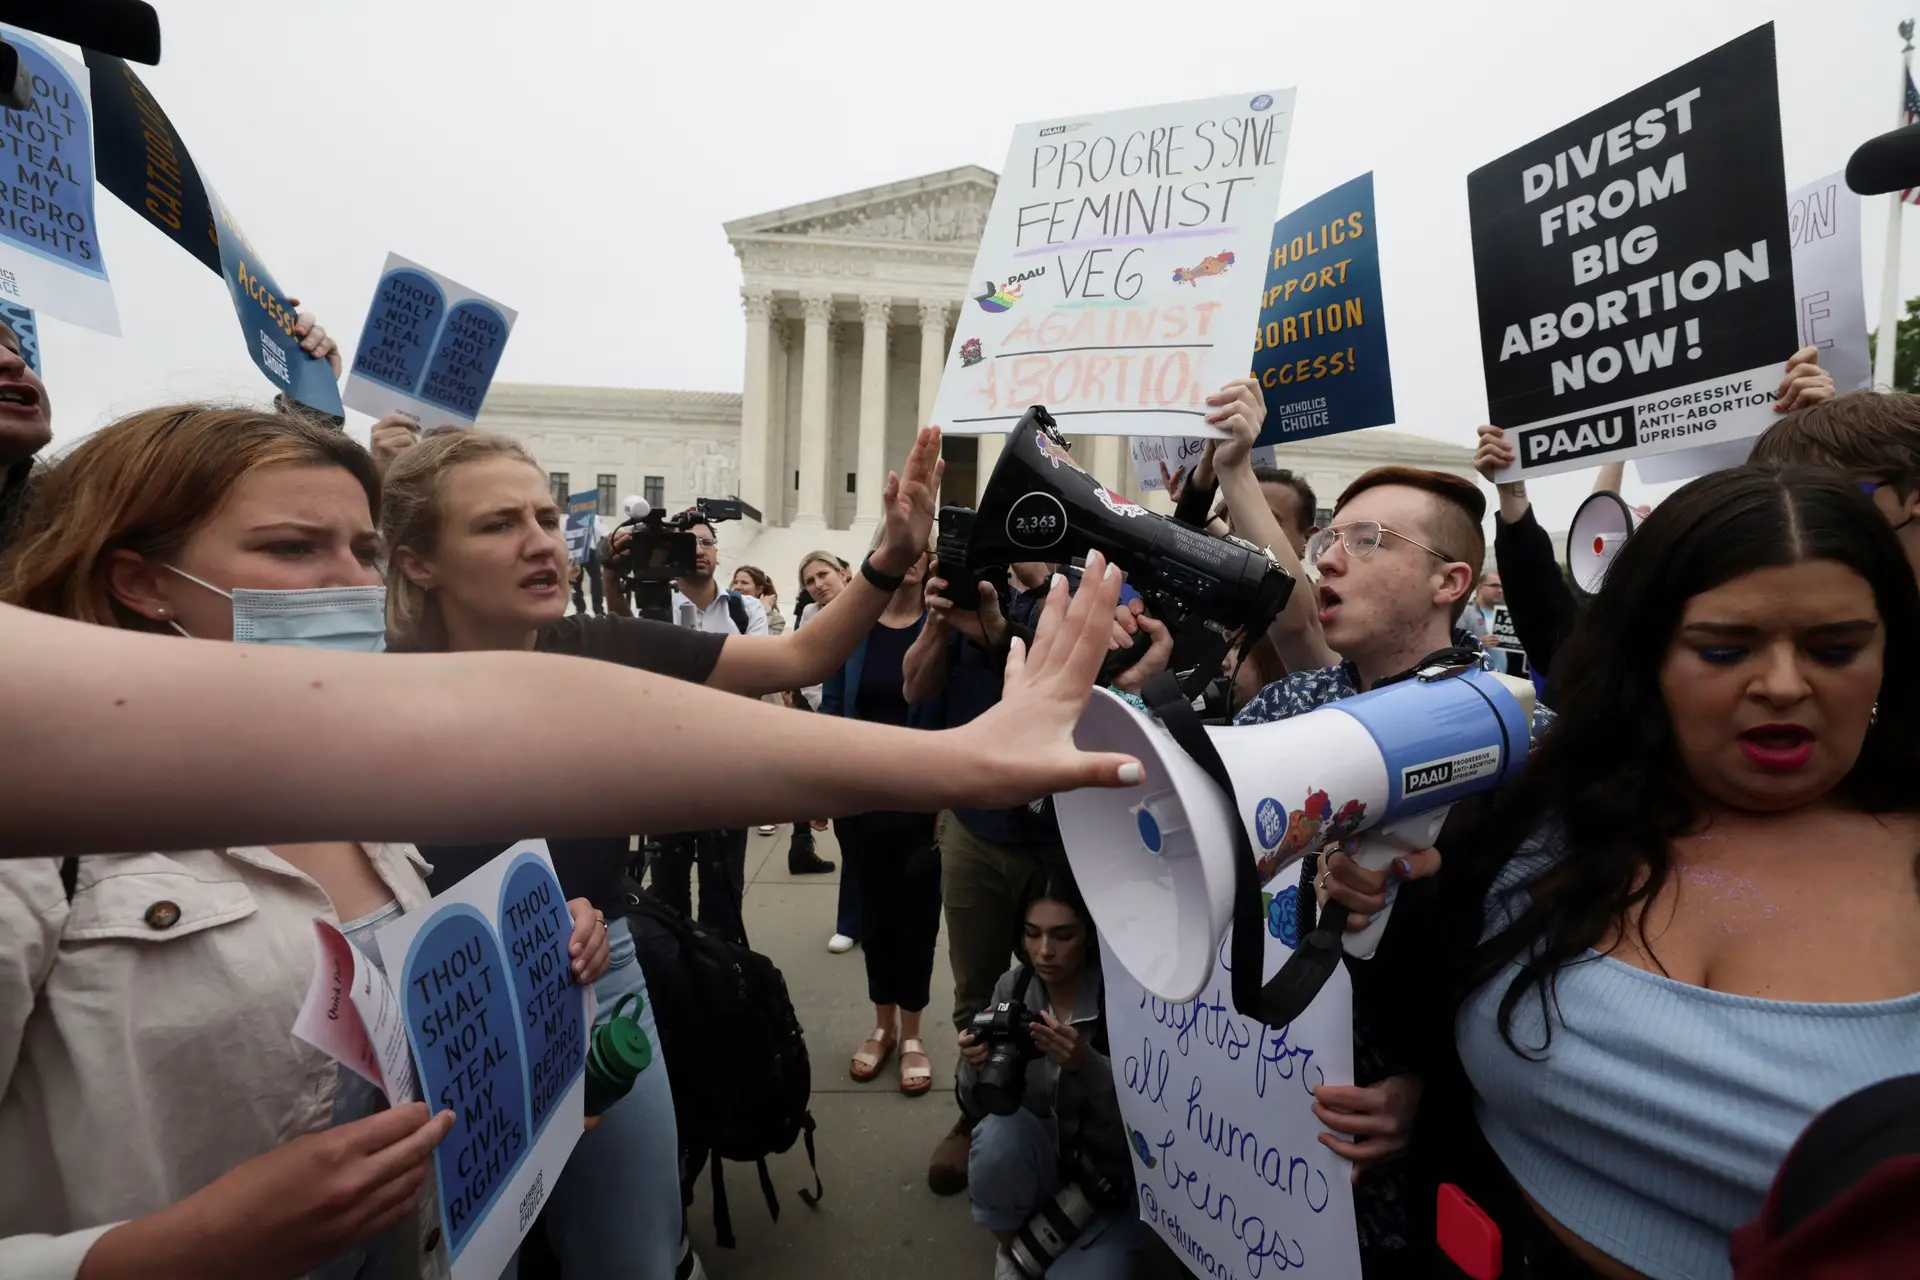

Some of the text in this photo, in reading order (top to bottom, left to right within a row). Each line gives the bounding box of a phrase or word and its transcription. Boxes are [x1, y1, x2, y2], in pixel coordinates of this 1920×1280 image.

[32, 74, 69, 109] OU
[4, 106, 63, 153] NOT
[30, 96, 76, 136] ALT
[1032, 111, 1287, 190] PROGRESSIVE
[1522, 86, 1701, 204] DIVEST
[18, 163, 59, 198] MY
[1539, 151, 1687, 247] FROM
[1015, 176, 1255, 248] FEMINIST
[1270, 211, 1364, 270] HOLICS
[1571, 224, 1659, 287] BIG
[391, 278, 436, 307] THOU
[1007, 265, 1046, 286] PAAU
[1057, 248, 1144, 301] VEG
[1260, 258, 1353, 310] UPPORT
[382, 290, 434, 320] SHALT
[385, 306, 420, 329] NOT
[458, 308, 499, 335] THOU
[1498, 238, 1771, 362] ABORTION
[374, 318, 422, 347] STEAL
[381, 336, 406, 354] MY
[449, 320, 497, 349] SHALT
[1000, 301, 1222, 348] AGAINST
[1253, 297, 1364, 353] BORTION
[262, 347, 291, 384] CHOICE
[369, 346, 408, 371] CIVIL
[440, 347, 485, 374] STEAL
[452, 338, 484, 357] NOT
[1550, 319, 1703, 396] NOW!
[357, 355, 413, 387] RIGHTS
[430, 371, 477, 398] REPRO
[447, 363, 470, 380] MY
[423, 382, 478, 411] RIGHTS
[1279, 397, 1327, 416] CATHOLICS
[1637, 379, 1753, 416] PROGRESSIVE
[1639, 388, 1780, 430] ANTI-ABORTION
[1281, 410, 1330, 433] CHOICE
[1528, 416, 1623, 461] PAAU
[1640, 419, 1717, 444] UPRISING
[1016, 515, 1057, 530] 2,363
[1495, 623, 1516, 635] POS
[1409, 766, 1449, 789] PAAU
[1453, 752, 1490, 767] PROGRESSIVE
[1453, 757, 1497, 774] ANTI-ABORTION
[504, 880, 551, 933] THOU
[511, 907, 562, 969] SHALT
[413, 935, 483, 1004] THOU
[527, 940, 561, 991] NOT
[421, 965, 493, 1048] SHALT
[526, 963, 574, 1029] STEAL
[444, 1008, 490, 1071] NOT
[543, 1002, 566, 1044] MY
[441, 1035, 509, 1111] STEAL
[533, 1017, 579, 1085] REPRO
[464, 1080, 496, 1135] MY
[532, 1051, 581, 1126] RIGHTS
[457, 1106, 511, 1179] CIVIL
[1124, 1037, 1329, 1214] all human
[448, 1121, 522, 1232] RIGHTS
[518, 1168, 544, 1213] CATHOLICS
[519, 1185, 546, 1234] CHOICE
[1157, 1129, 1305, 1279] beings
